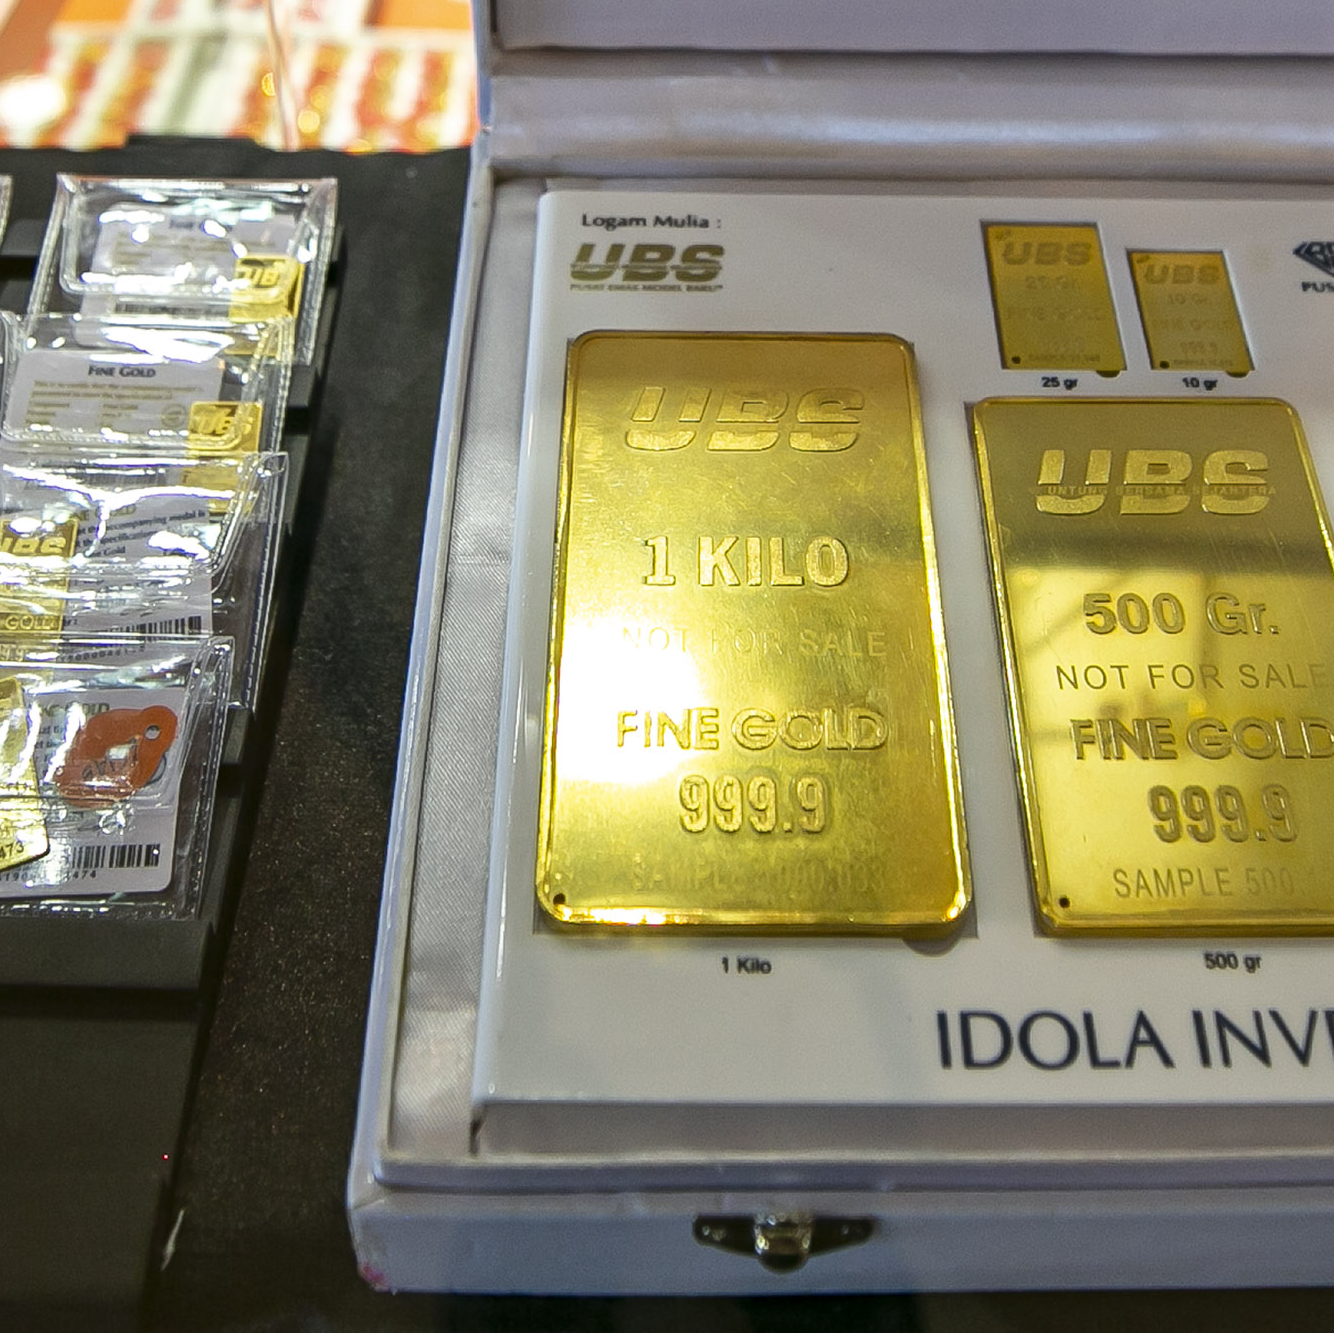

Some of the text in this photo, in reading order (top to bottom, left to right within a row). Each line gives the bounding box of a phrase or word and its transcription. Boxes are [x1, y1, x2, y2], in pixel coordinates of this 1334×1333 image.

[581, 213, 710, 232] Logam Mulia
[570, 242, 725, 283] UBS
[1002, 241, 1092, 266] UBS
[88, 365, 157, 378] FINE GOLD
[1041, 376, 1078, 391] 25 gr
[1182, 376, 1218, 391] 10 gr
[625, 385, 865, 453] UBS
[1035, 448, 1271, 516] UBS
[642, 535, 849, 587] 1 KILO
[1082, 592, 1281, 637] 500 Gr.
[622, 626, 690, 653] NOT
[800, 630, 888, 658] SALE
[1056, 663, 1327, 691] NOT FOR SALE
[616, 707, 891, 752] FINE GOLD
[1069, 717, 1178, 761] FINE
[679, 774, 828, 835] 999.9
[1147, 783, 1299, 845] 999.9
[1113, 866, 1234, 900] SAMPLE
[720, 956, 773, 975] 1 Kilo
[1203, 951, 1263, 974] 500 gr
[936, 1007, 1176, 1071] IDOLA
